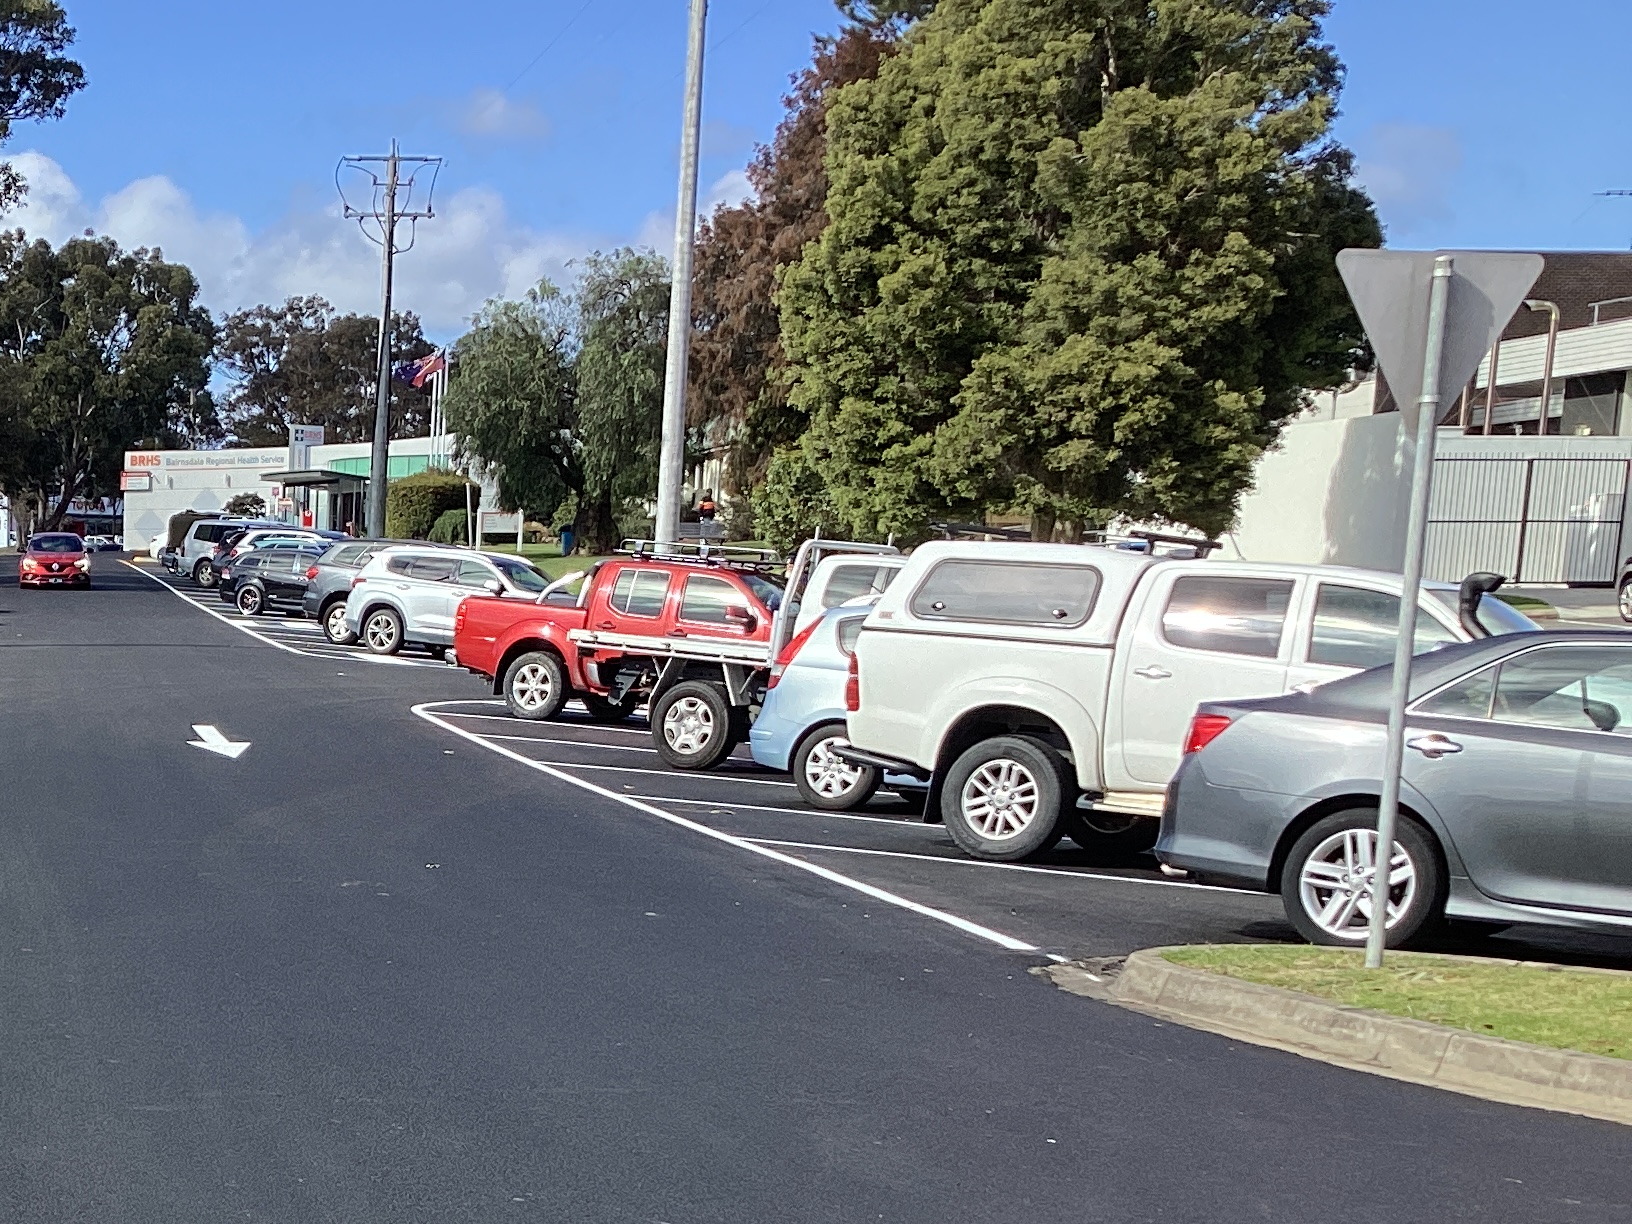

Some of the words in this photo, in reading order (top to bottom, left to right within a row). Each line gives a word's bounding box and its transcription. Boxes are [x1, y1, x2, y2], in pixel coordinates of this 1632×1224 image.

[130, 455, 162, 467] BRHS
[165, 457, 204, 466] Bairnsdale
[206, 456, 236, 467] Regional
[237, 456, 260, 465] Health
[261, 455, 285, 464] Service
